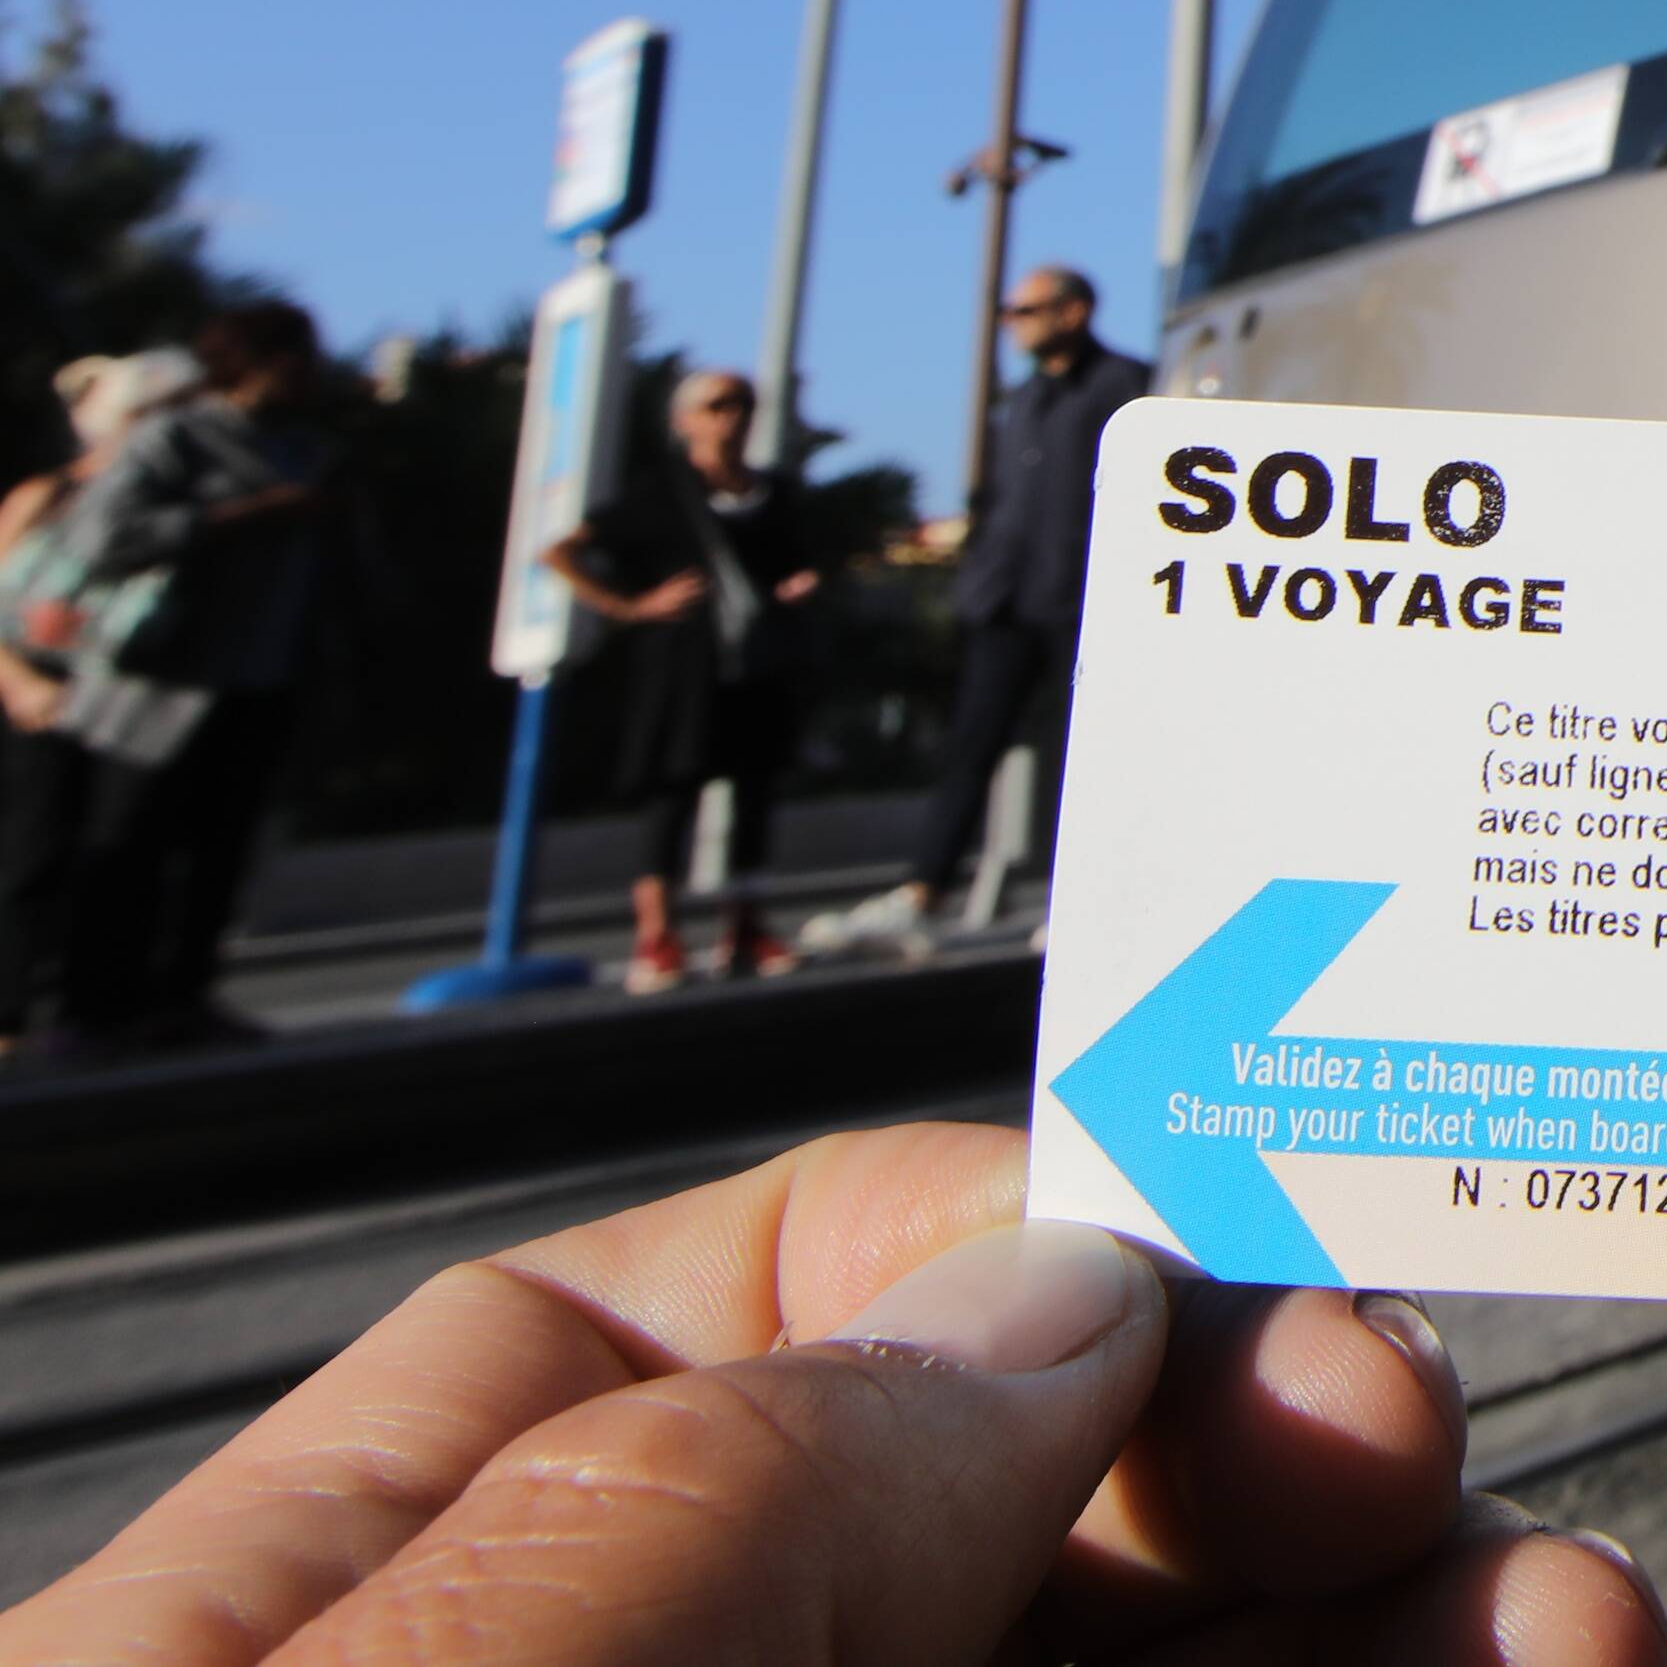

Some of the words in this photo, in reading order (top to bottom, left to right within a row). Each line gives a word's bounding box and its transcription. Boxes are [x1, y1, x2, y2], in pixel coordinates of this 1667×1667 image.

[1158, 446, 1506, 548] SOLO
[1154, 561, 1185, 614] 1
[1226, 563, 1565, 634] VOYAGE
[1488, 702, 1533, 736] Ce
[1550, 705, 1616, 741] titre
[1483, 750, 1577, 793] (sauf
[1479, 809, 1560, 835] avec
[1473, 849, 1557, 885] mais
[1573, 862, 1616, 887] ne
[1470, 896, 1533, 932] Les
[1549, 900, 1640, 937] titres
[1231, 1043, 1359, 1089] Validez
[1373, 1050, 1391, 1091] à
[1405, 1050, 1534, 1104] chaque
[1167, 1092, 1276, 1148] Stamp
[1285, 1106, 1363, 1148] your
[1376, 1103, 1474, 1146] ticket
[1487, 1112, 1575, 1151] when
[1453, 1166, 1480, 1206] N
